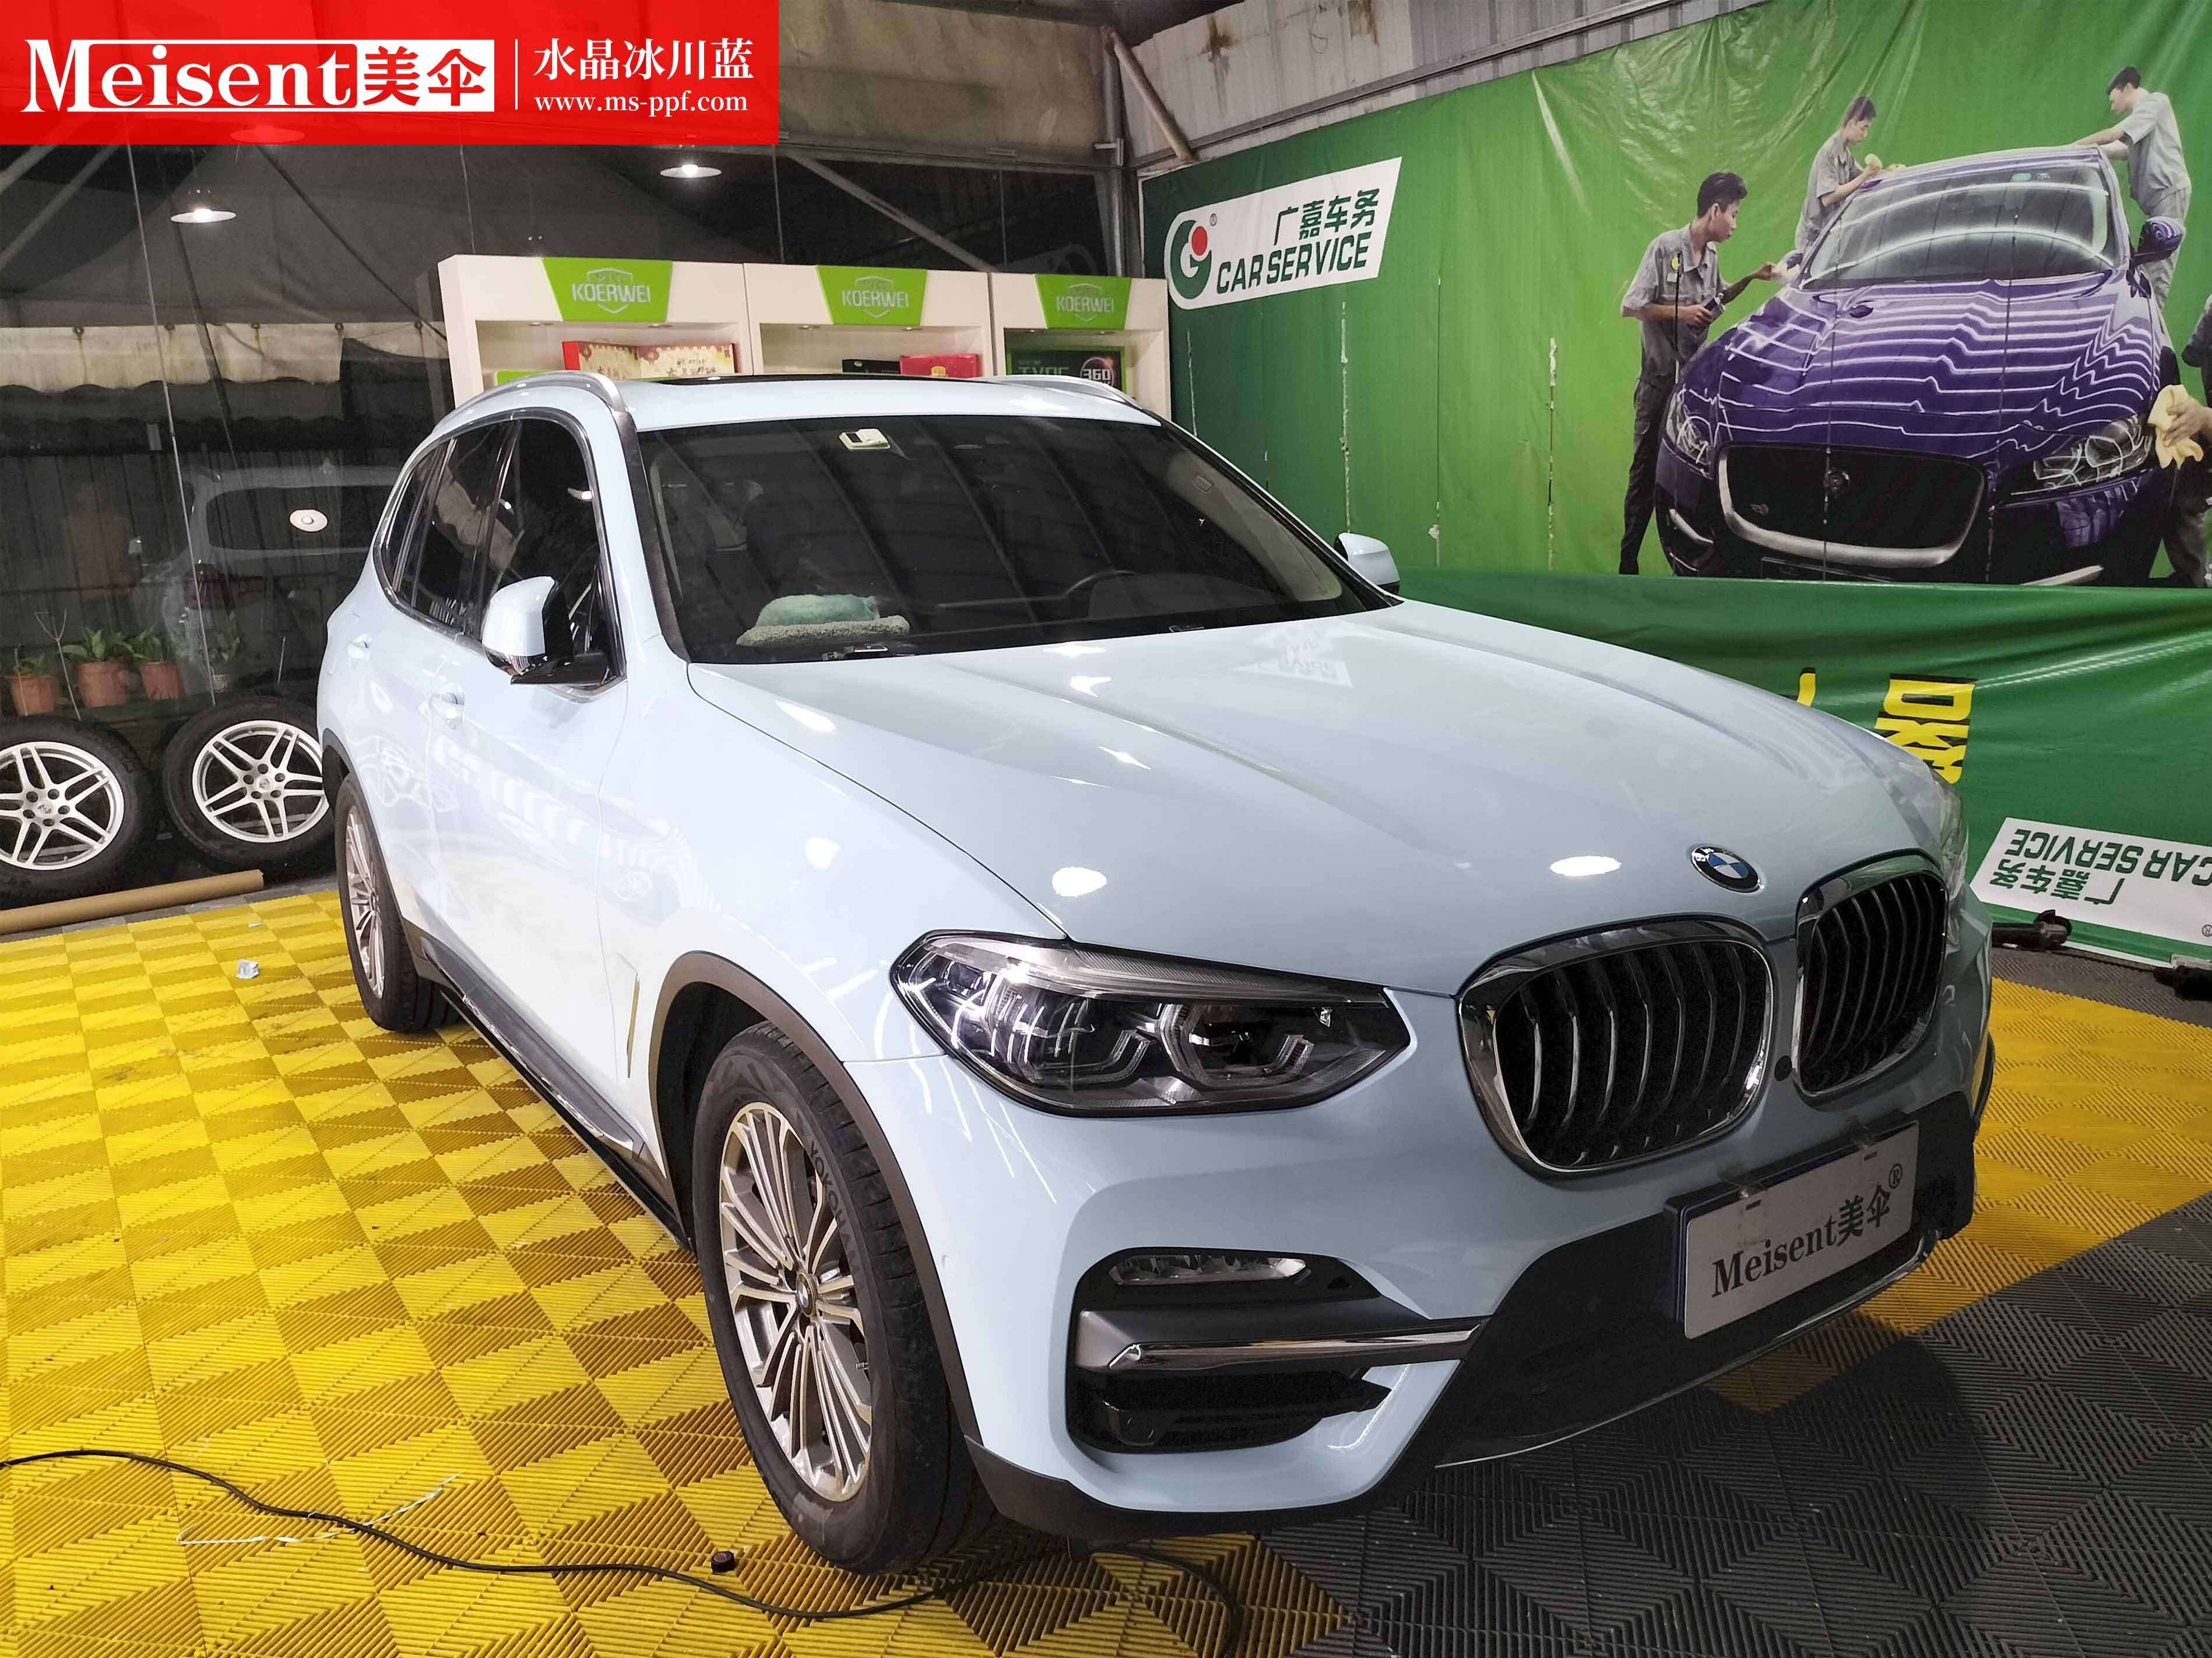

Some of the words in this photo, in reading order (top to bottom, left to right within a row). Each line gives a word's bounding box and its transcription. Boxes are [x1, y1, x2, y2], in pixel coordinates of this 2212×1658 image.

[1274, 188, 1380, 246] 广嘉车务
[571, 283, 652, 303] KOERWEI
[842, 289, 909, 308] KOERWEI
[1056, 294, 1115, 313] KOERWEI
[1082, 368, 1111, 381] 360
[2004, 828, 2144, 874] SERVICE
[1989, 858, 2126, 905] 广嘉车务
